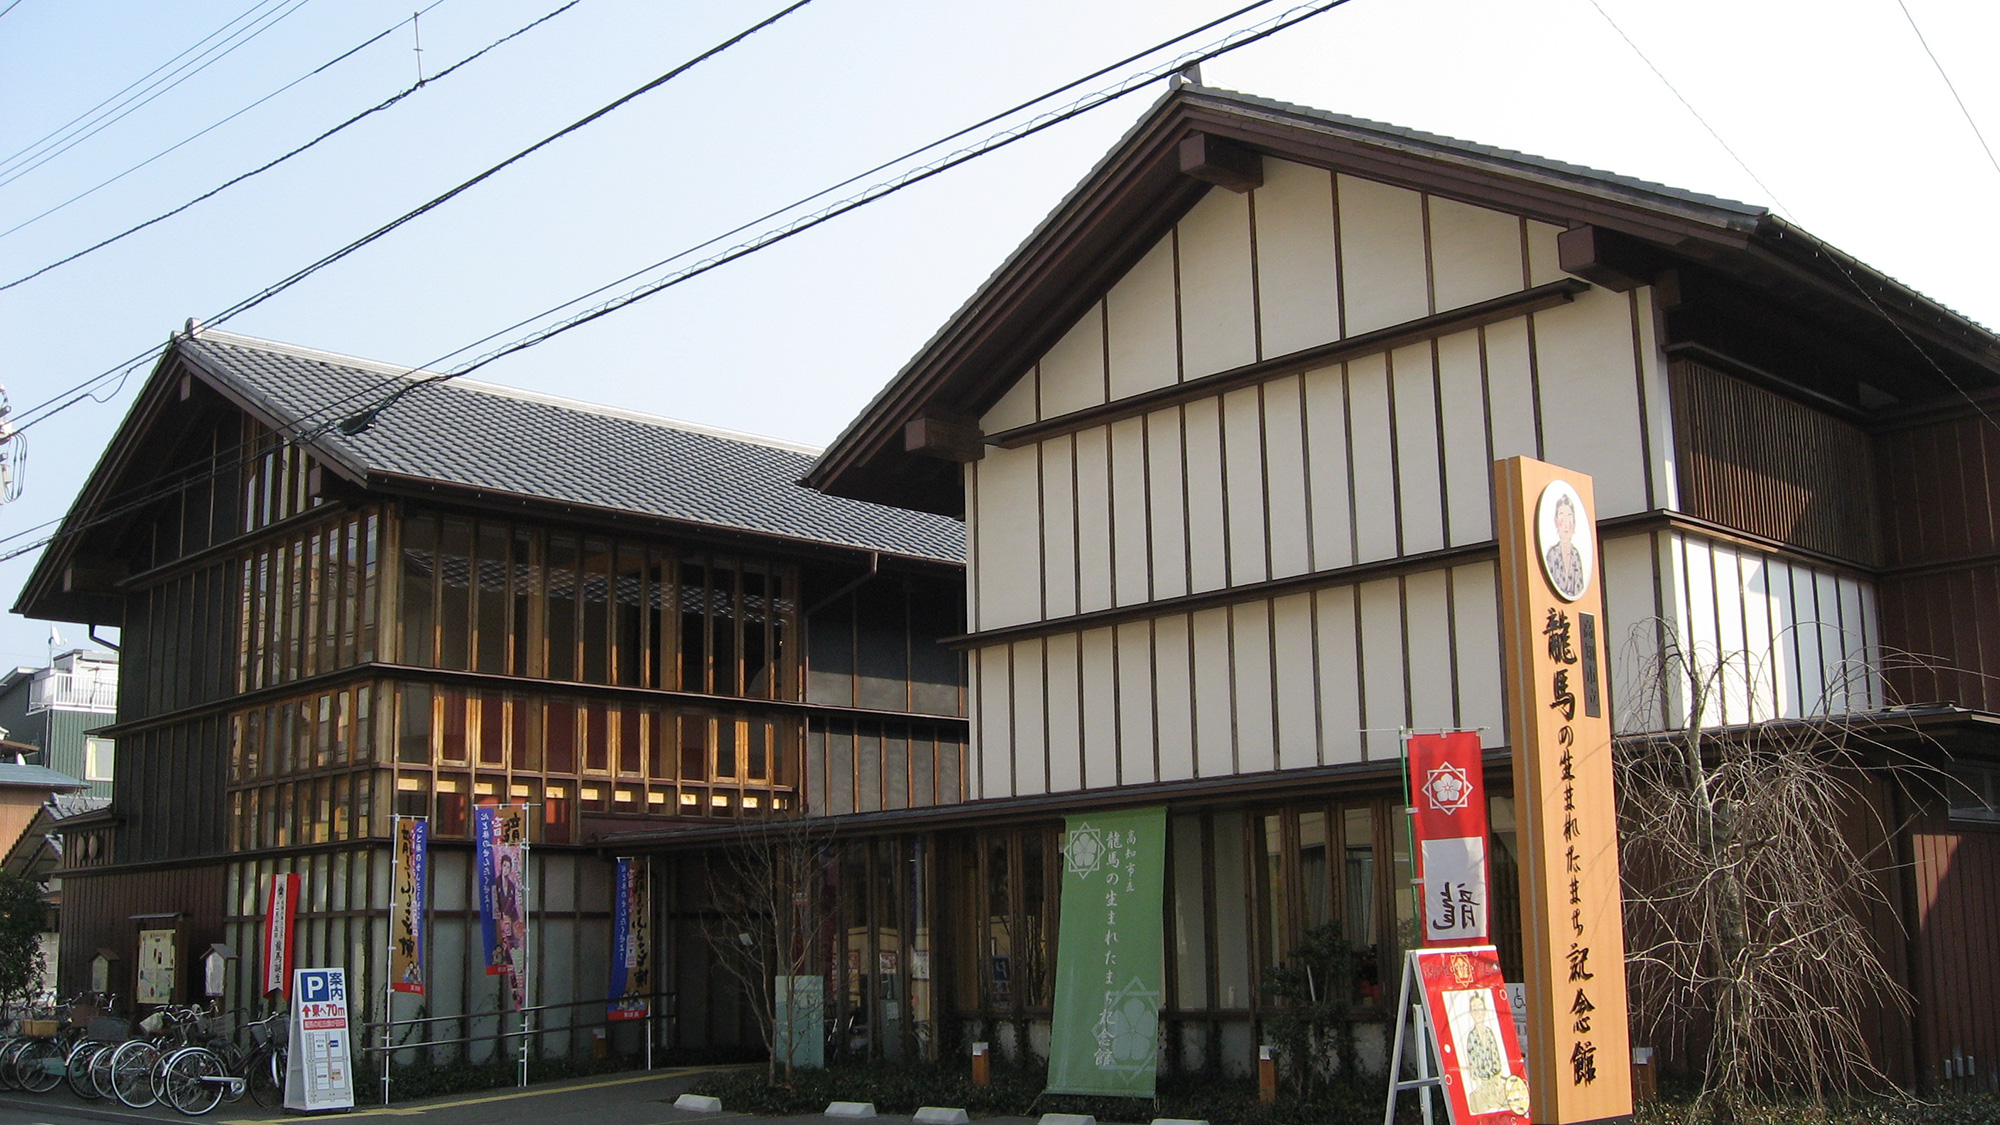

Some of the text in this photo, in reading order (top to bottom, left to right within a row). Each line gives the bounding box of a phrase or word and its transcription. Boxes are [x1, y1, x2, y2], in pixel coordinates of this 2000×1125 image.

[1583, 619, 1599, 707] 高知市立
[1124, 829, 1137, 893] 高知市立
[1541, 606, 1598, 1087] 龍馬の生まれたまち記念館
[329, 971, 344, 1001] 案内
[1093, 830, 1123, 1067] 龍馬の生まれたまち記念館
[307, 975, 324, 999] P
